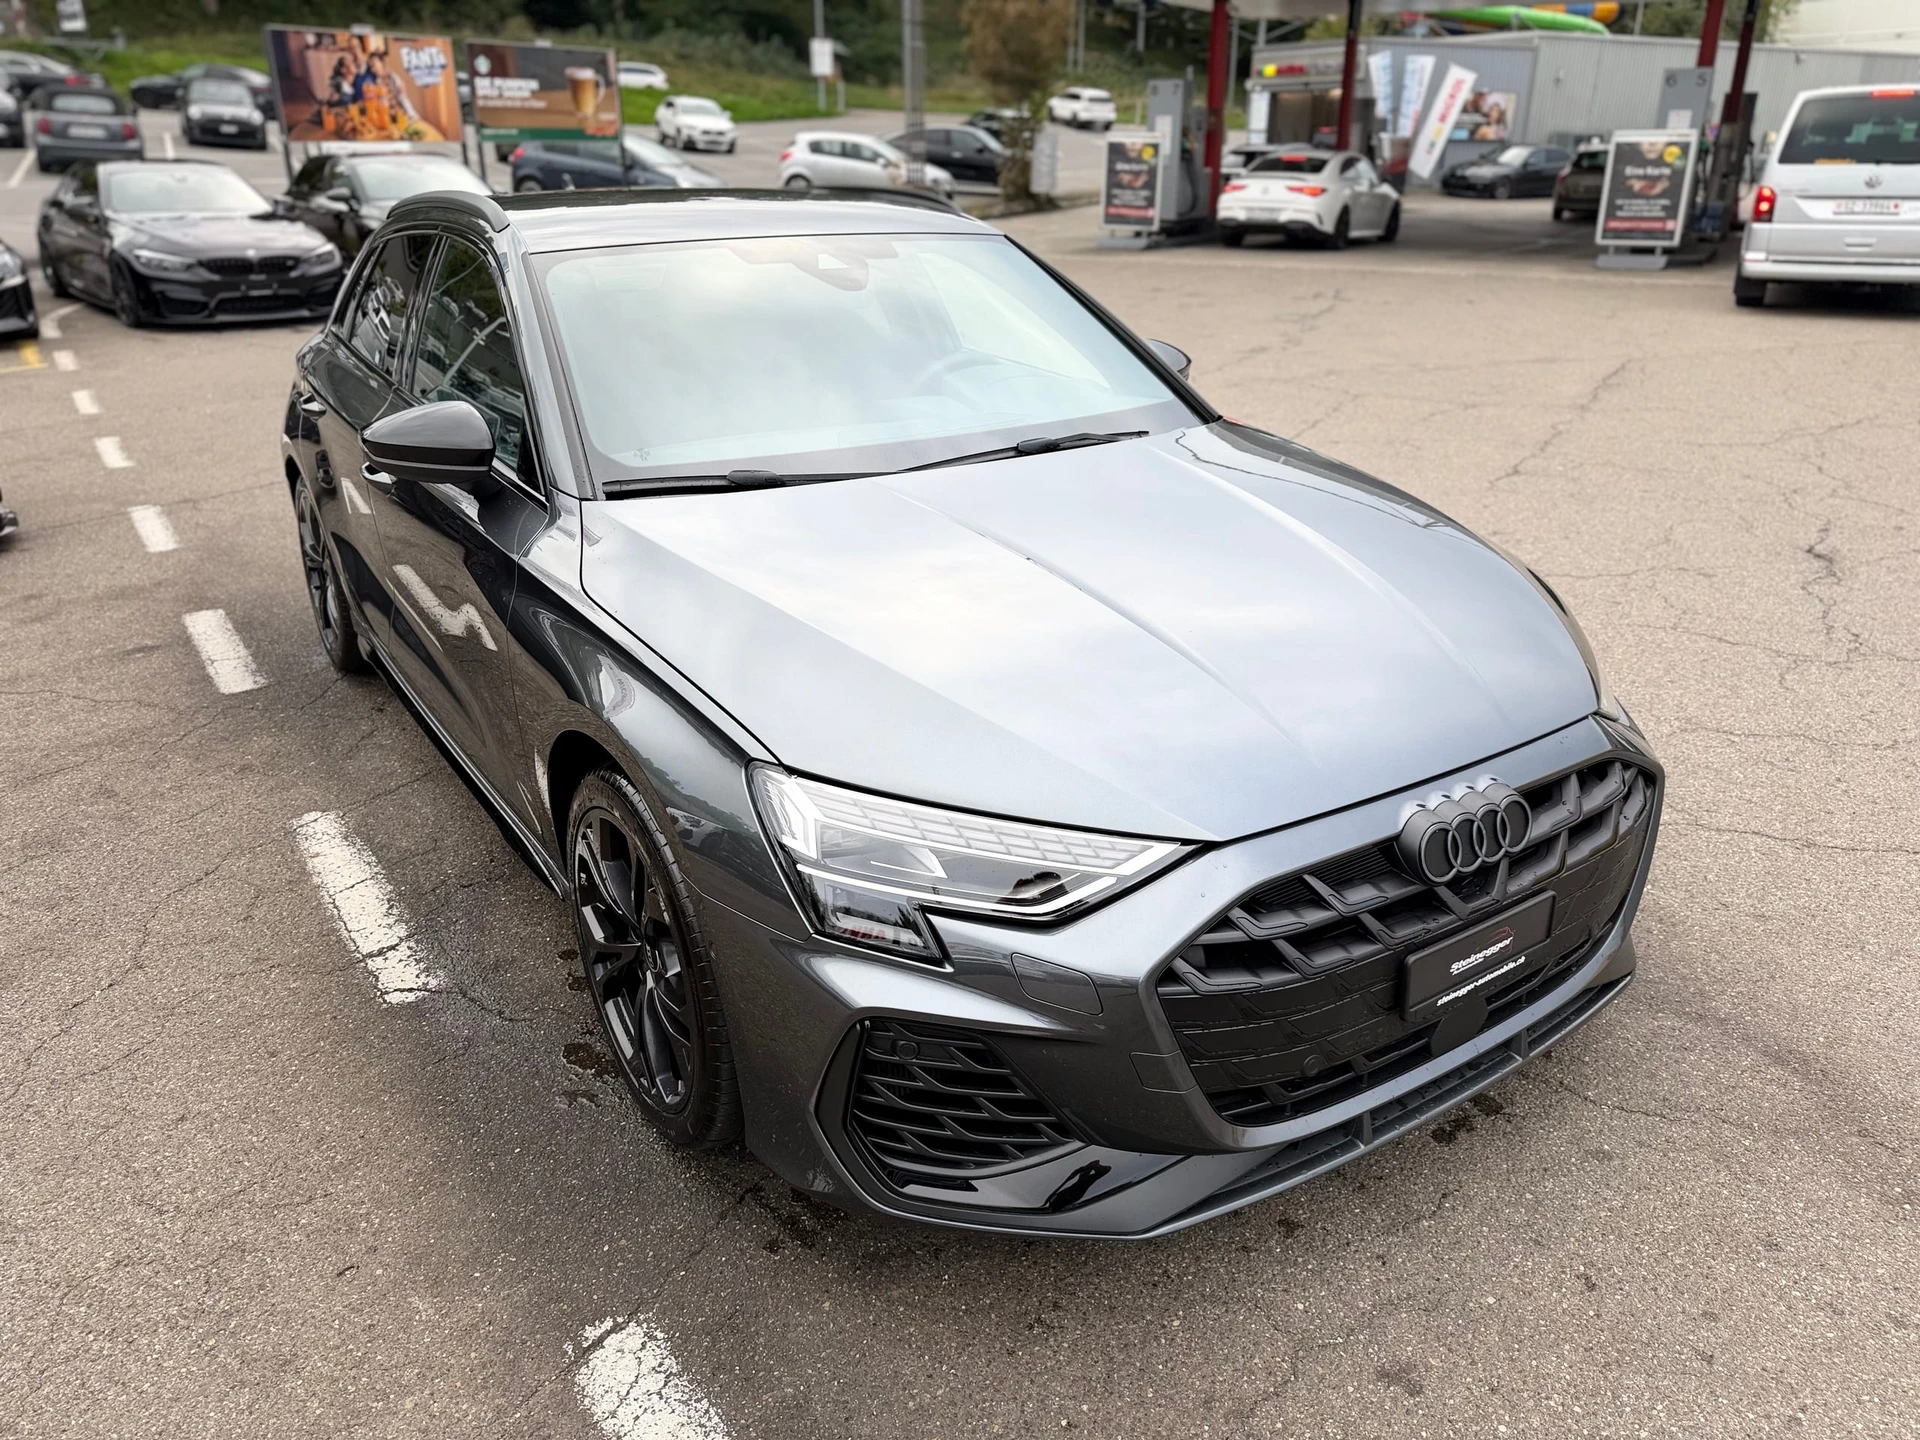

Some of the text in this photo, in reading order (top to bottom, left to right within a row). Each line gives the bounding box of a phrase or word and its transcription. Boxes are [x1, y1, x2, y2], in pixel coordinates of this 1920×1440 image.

[1665, 72, 1707, 87] 6 5
[1449, 936, 1514, 973] Steinegger
